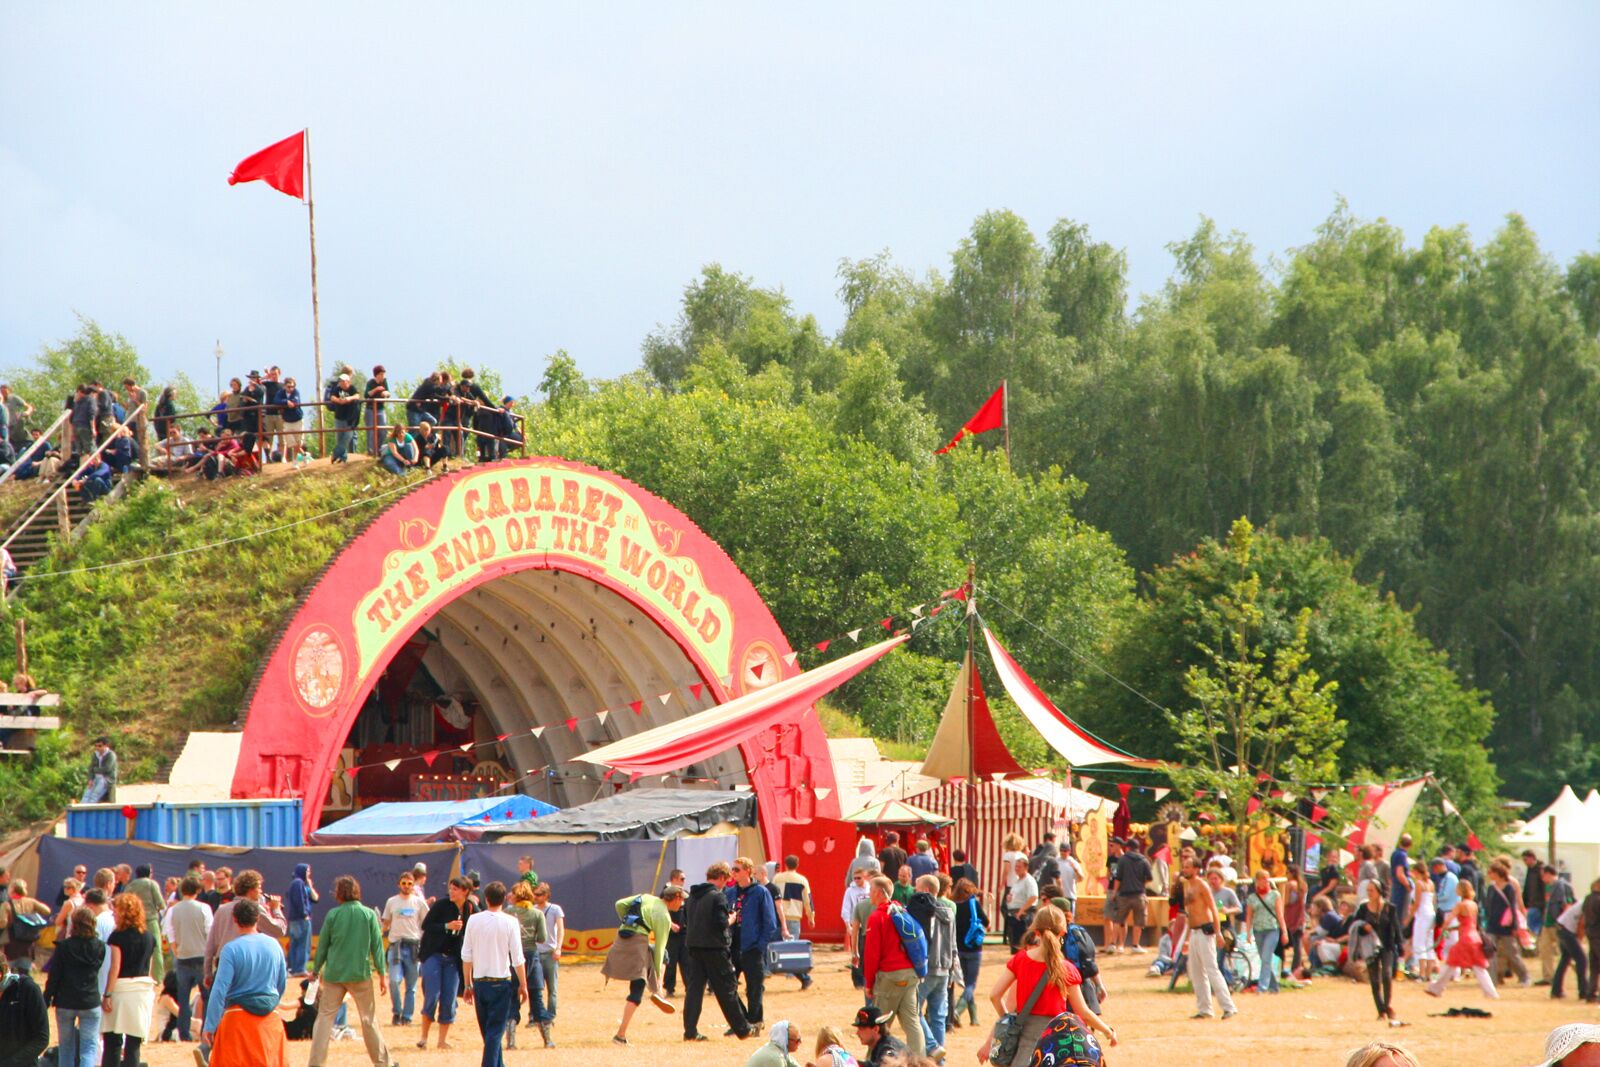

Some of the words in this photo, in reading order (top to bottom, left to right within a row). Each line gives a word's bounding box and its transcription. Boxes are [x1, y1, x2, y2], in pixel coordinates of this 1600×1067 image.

[464, 476, 623, 528] CABARET
[367, 560, 430, 632] THE
[431, 524, 496, 582] END
[505, 515, 541, 551] OF
[551, 515, 610, 560] THE
[619, 534, 721, 643] WORLD
